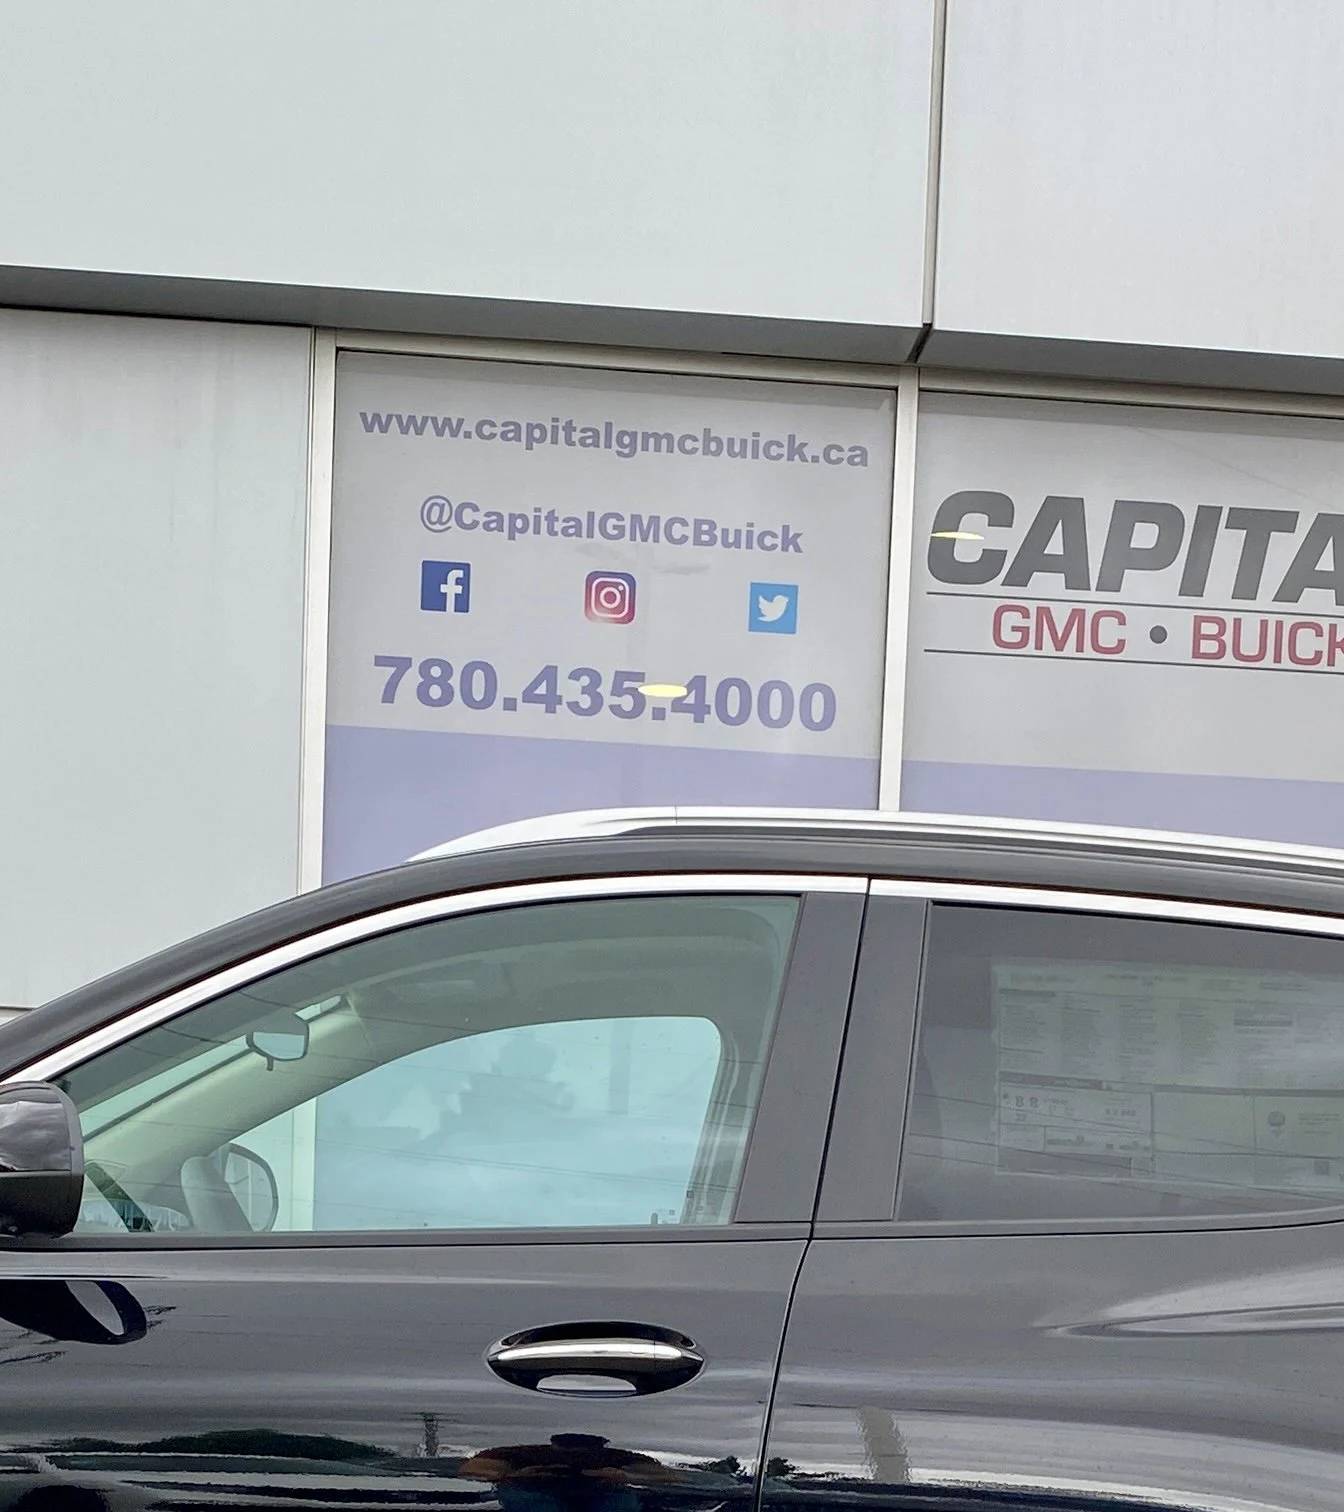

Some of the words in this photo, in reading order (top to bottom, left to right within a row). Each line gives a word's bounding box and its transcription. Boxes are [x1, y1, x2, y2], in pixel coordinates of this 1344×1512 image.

[359, 410, 869, 467] www.capitalgmcbuick.ca
[420, 495, 805, 554] @CapitalGMCBuick
[992, 604, 1126, 655] GMC
[373, 655, 837, 732] 780.435.4000
